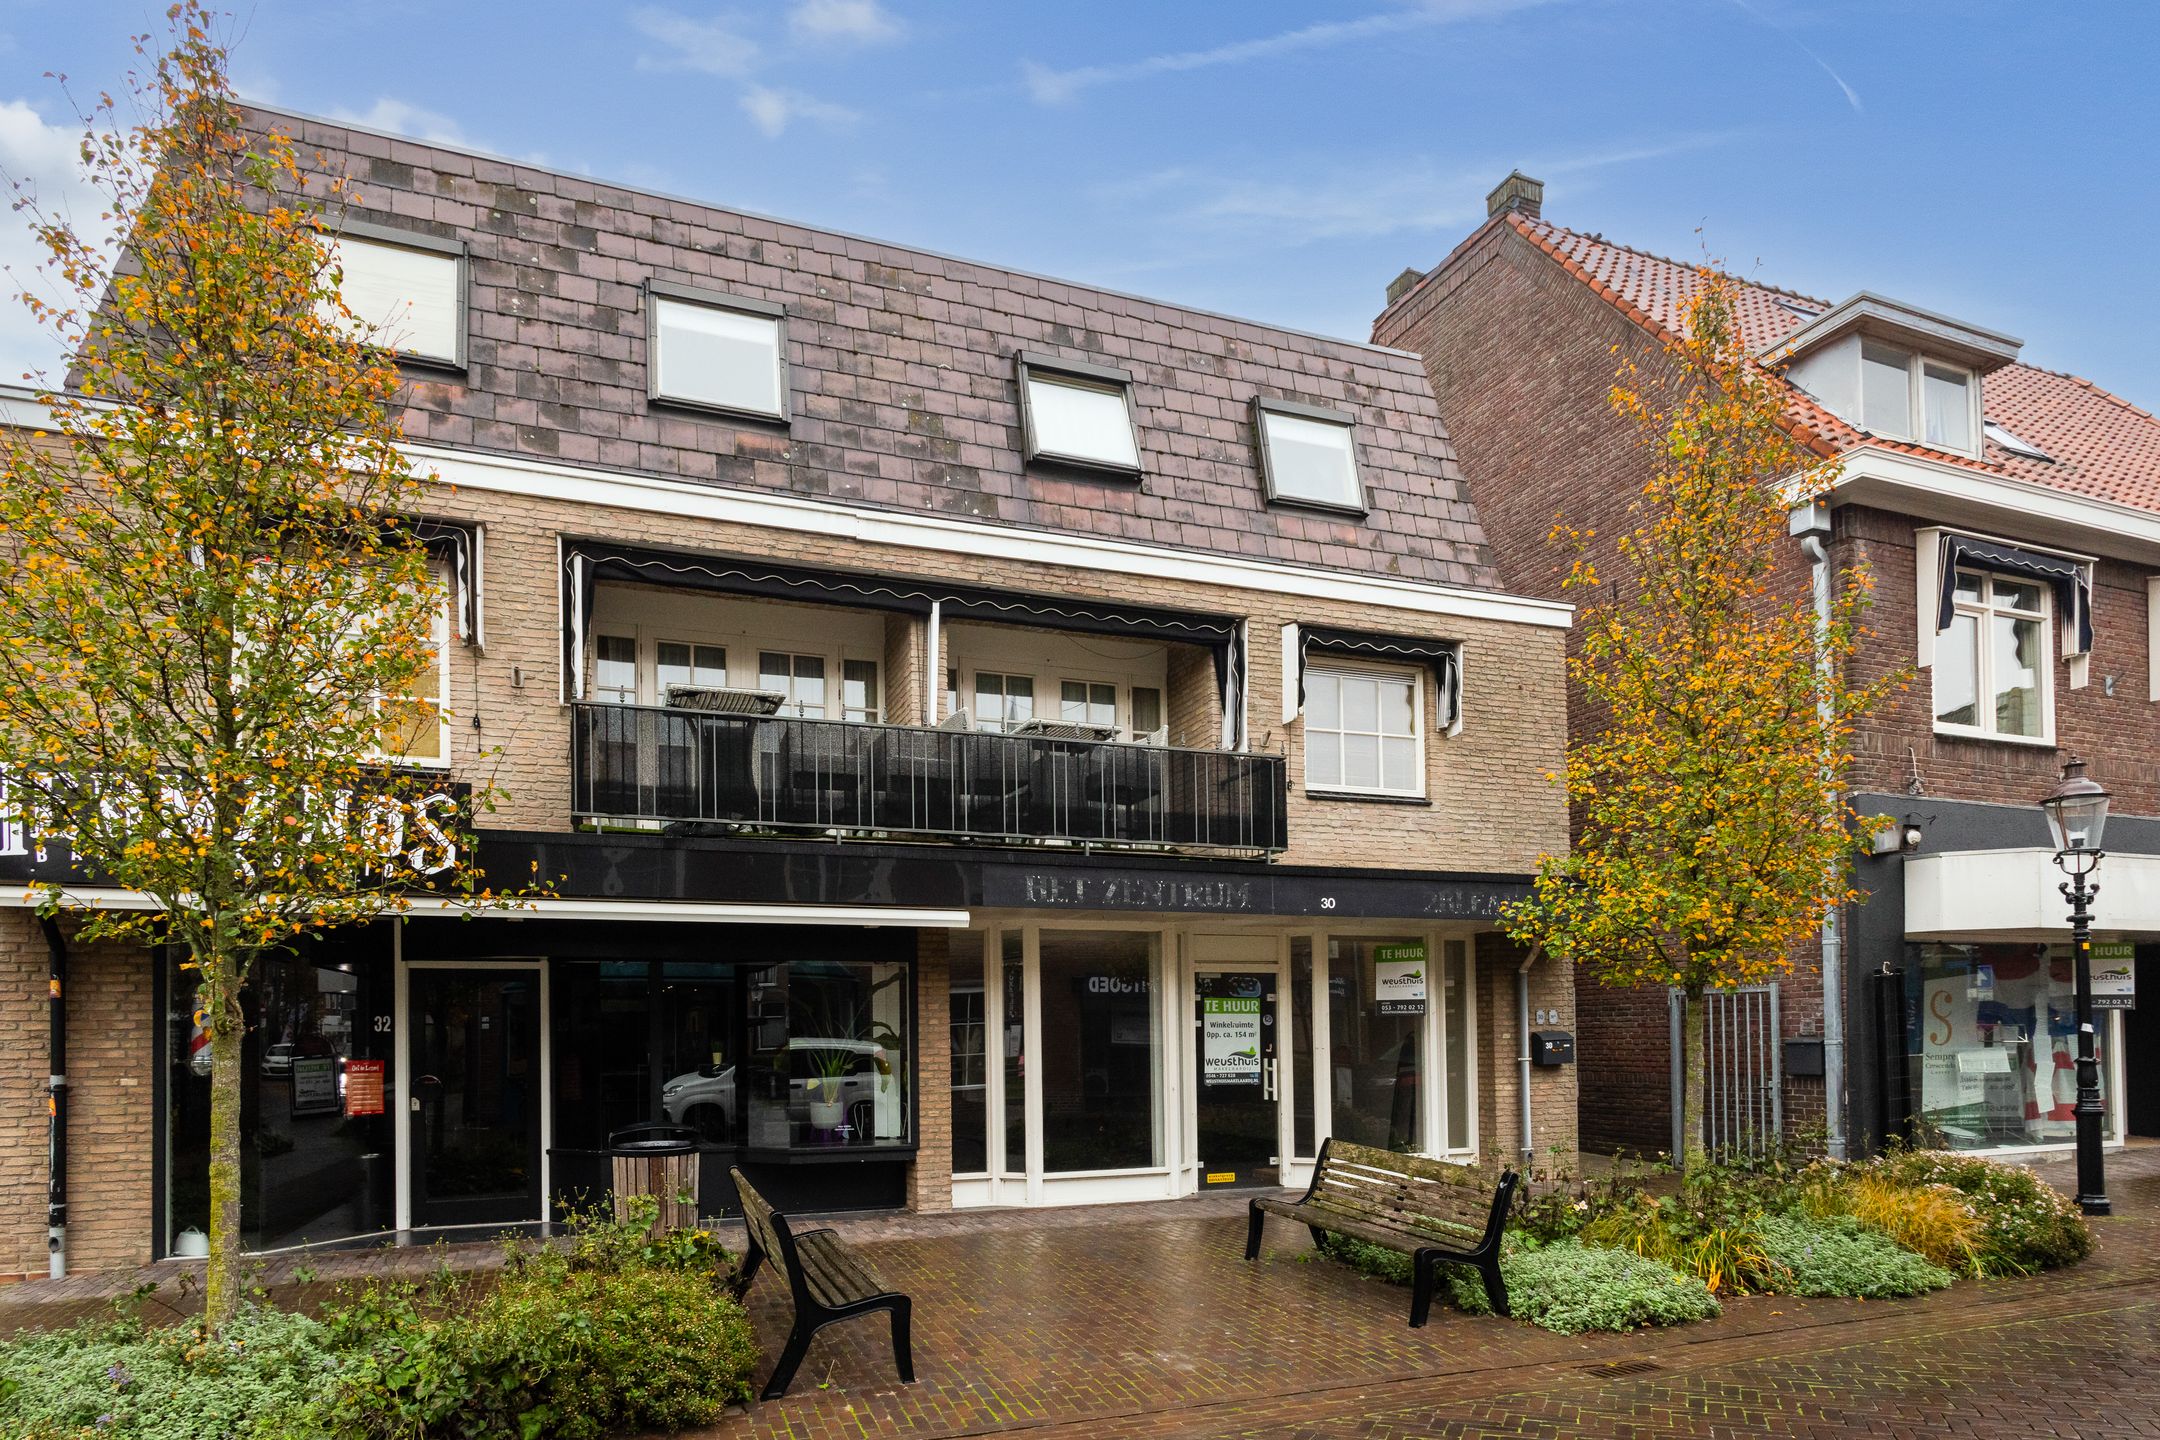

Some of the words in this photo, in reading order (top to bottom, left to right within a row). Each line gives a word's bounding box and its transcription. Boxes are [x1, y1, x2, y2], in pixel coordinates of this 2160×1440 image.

[1320, 898, 1336, 909] 30
[1381, 949, 1393, 959] TE
[1394, 947, 1424, 959] HUUR
[2095, 946, 2132, 956] HUUR
[1382, 977, 1424, 985] weusthuis
[1204, 1000, 1219, 1012] TE
[1223, 1000, 1259, 1012] HUUR
[374, 1015, 391, 1032] 32
[1210, 1020, 1254, 1029] Winkelruimte
[1545, 1041, 1553, 1049] 30
[1205, 1057, 1259, 1066] weusthuis
[1925, 1053, 1956, 1062] Sempre
